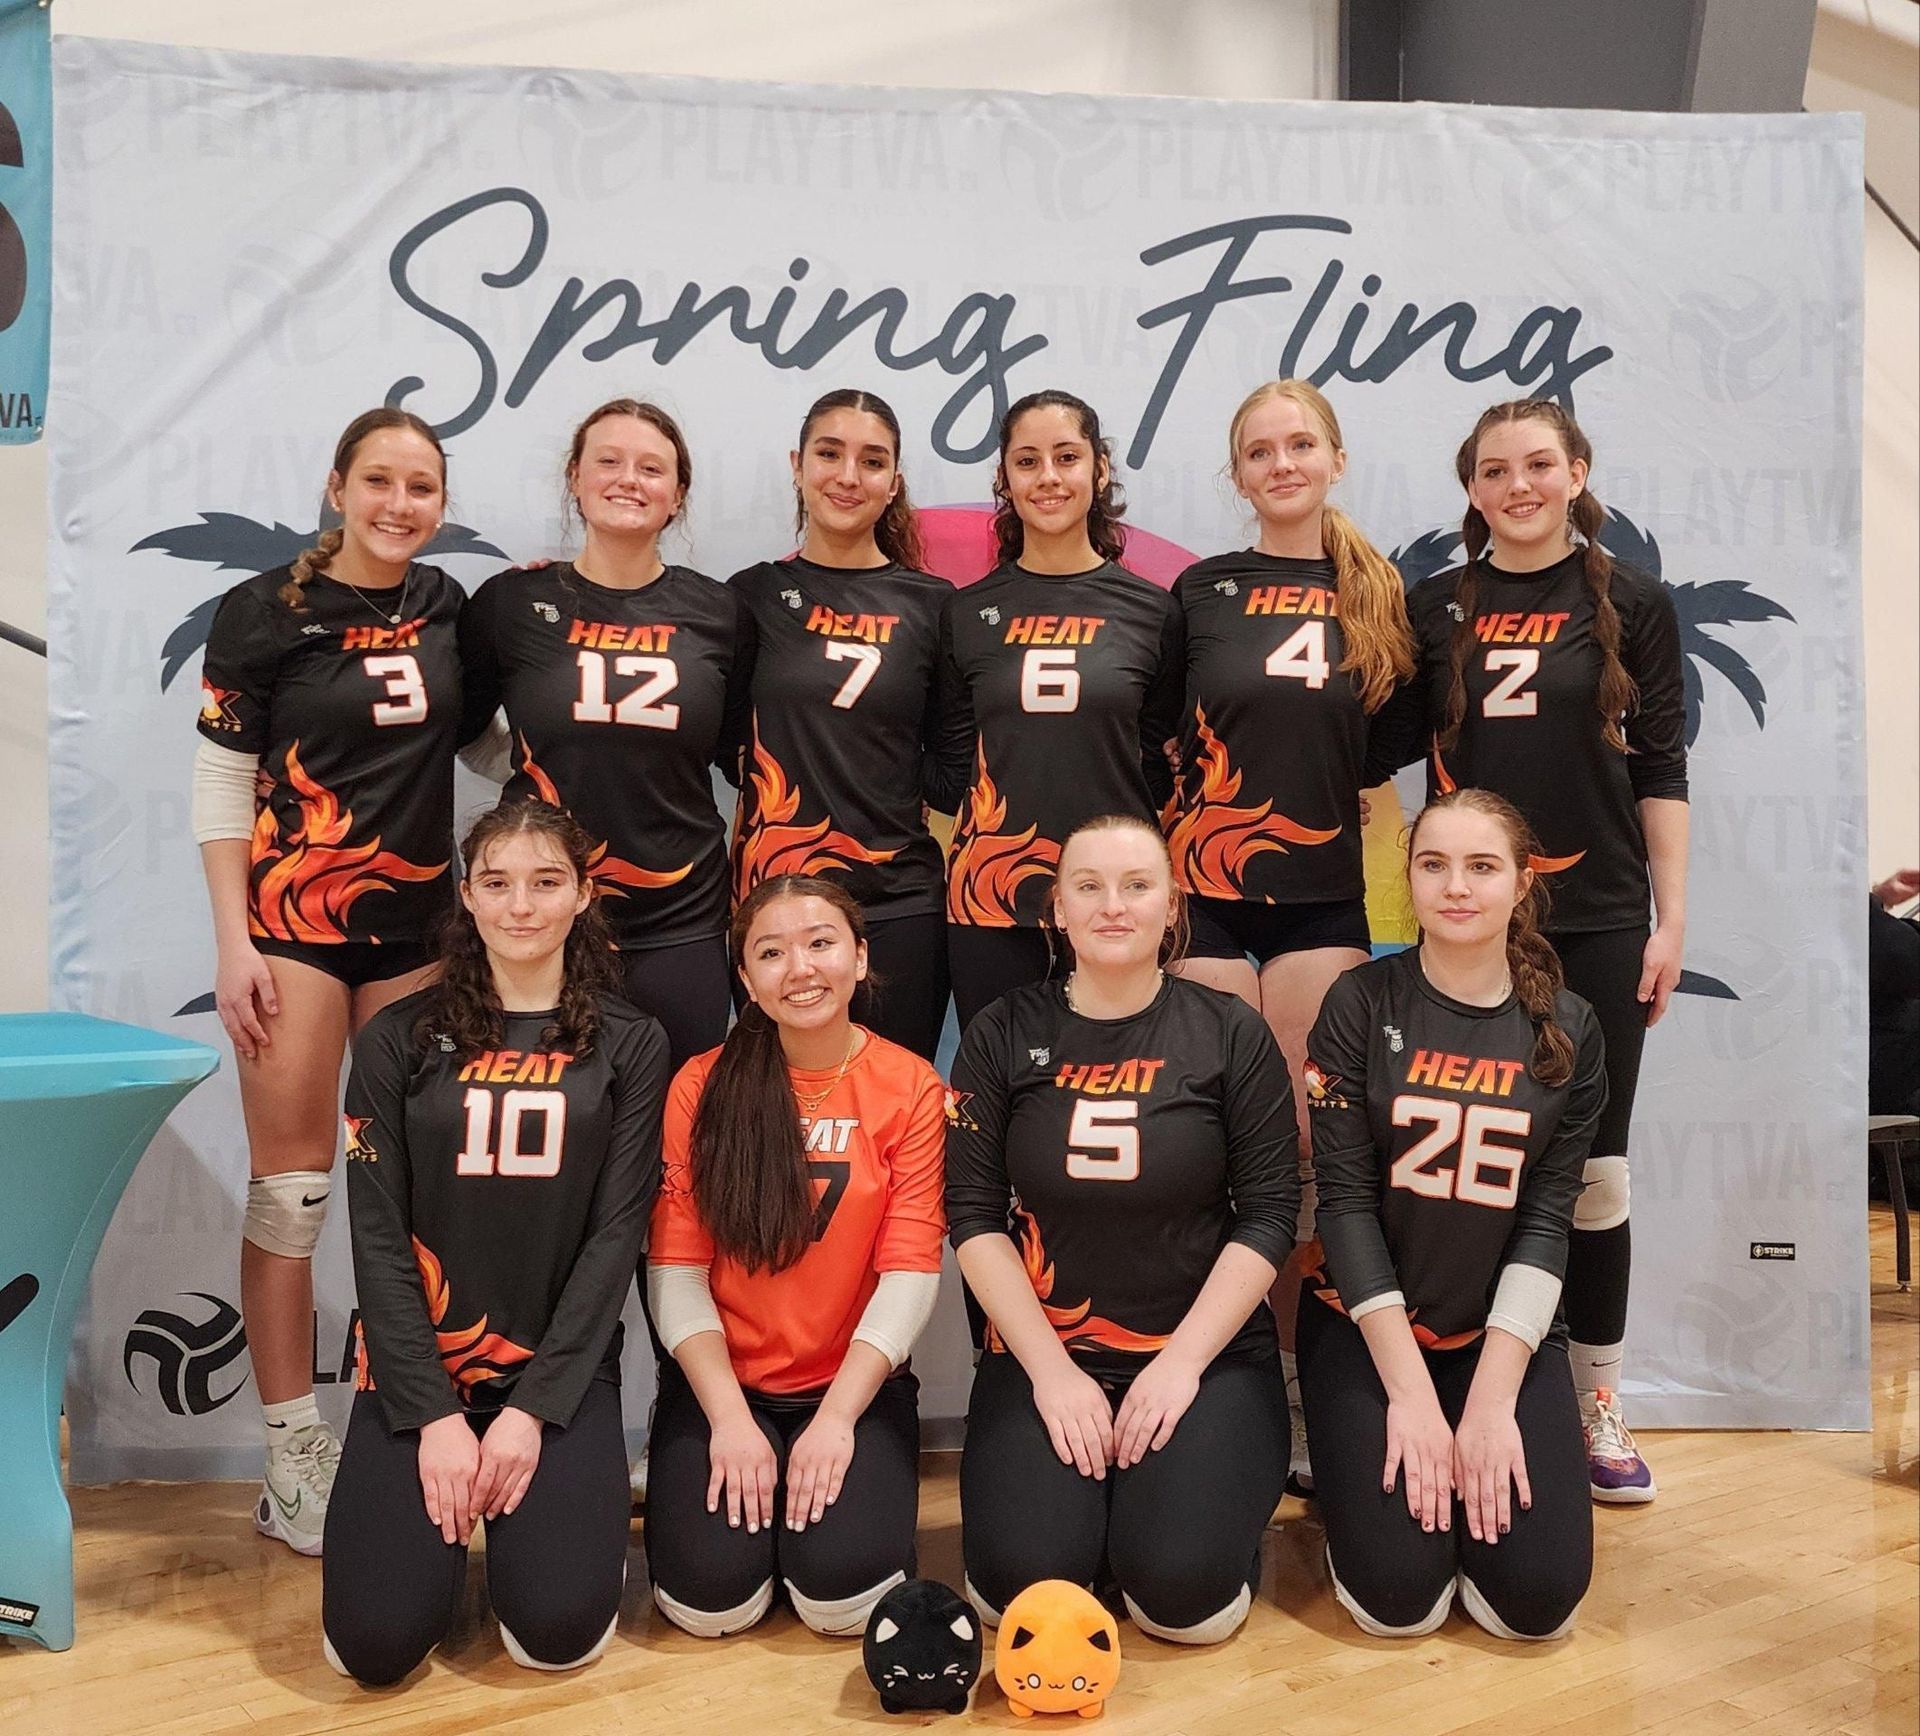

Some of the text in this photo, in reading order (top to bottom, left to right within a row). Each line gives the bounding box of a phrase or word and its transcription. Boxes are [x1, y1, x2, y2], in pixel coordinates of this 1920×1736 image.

[384, 186, 1614, 470] Spring Fling
[805, 605, 900, 643] HEAT
[1004, 616, 1106, 645] HEAT
[1245, 585, 1338, 616] HEAT
[1475, 612, 1570, 643] HEAT
[567, 619, 677, 653] HEAT
[1265, 620, 1329, 690] 4
[363, 654, 428, 726] 3
[573, 650, 681, 731] 12
[825, 640, 882, 710] 7
[1021, 649, 1080, 713] 6
[1482, 648, 1540, 718] 2
[458, 1050, 575, 1085] HEAT
[1055, 1058, 1166, 1095] HEAT
[1406, 1048, 1524, 1097] HEAT
[456, 1087, 567, 1178] 10
[1065, 1098, 1141, 1180] 5
[1390, 1094, 1533, 1210] 26
